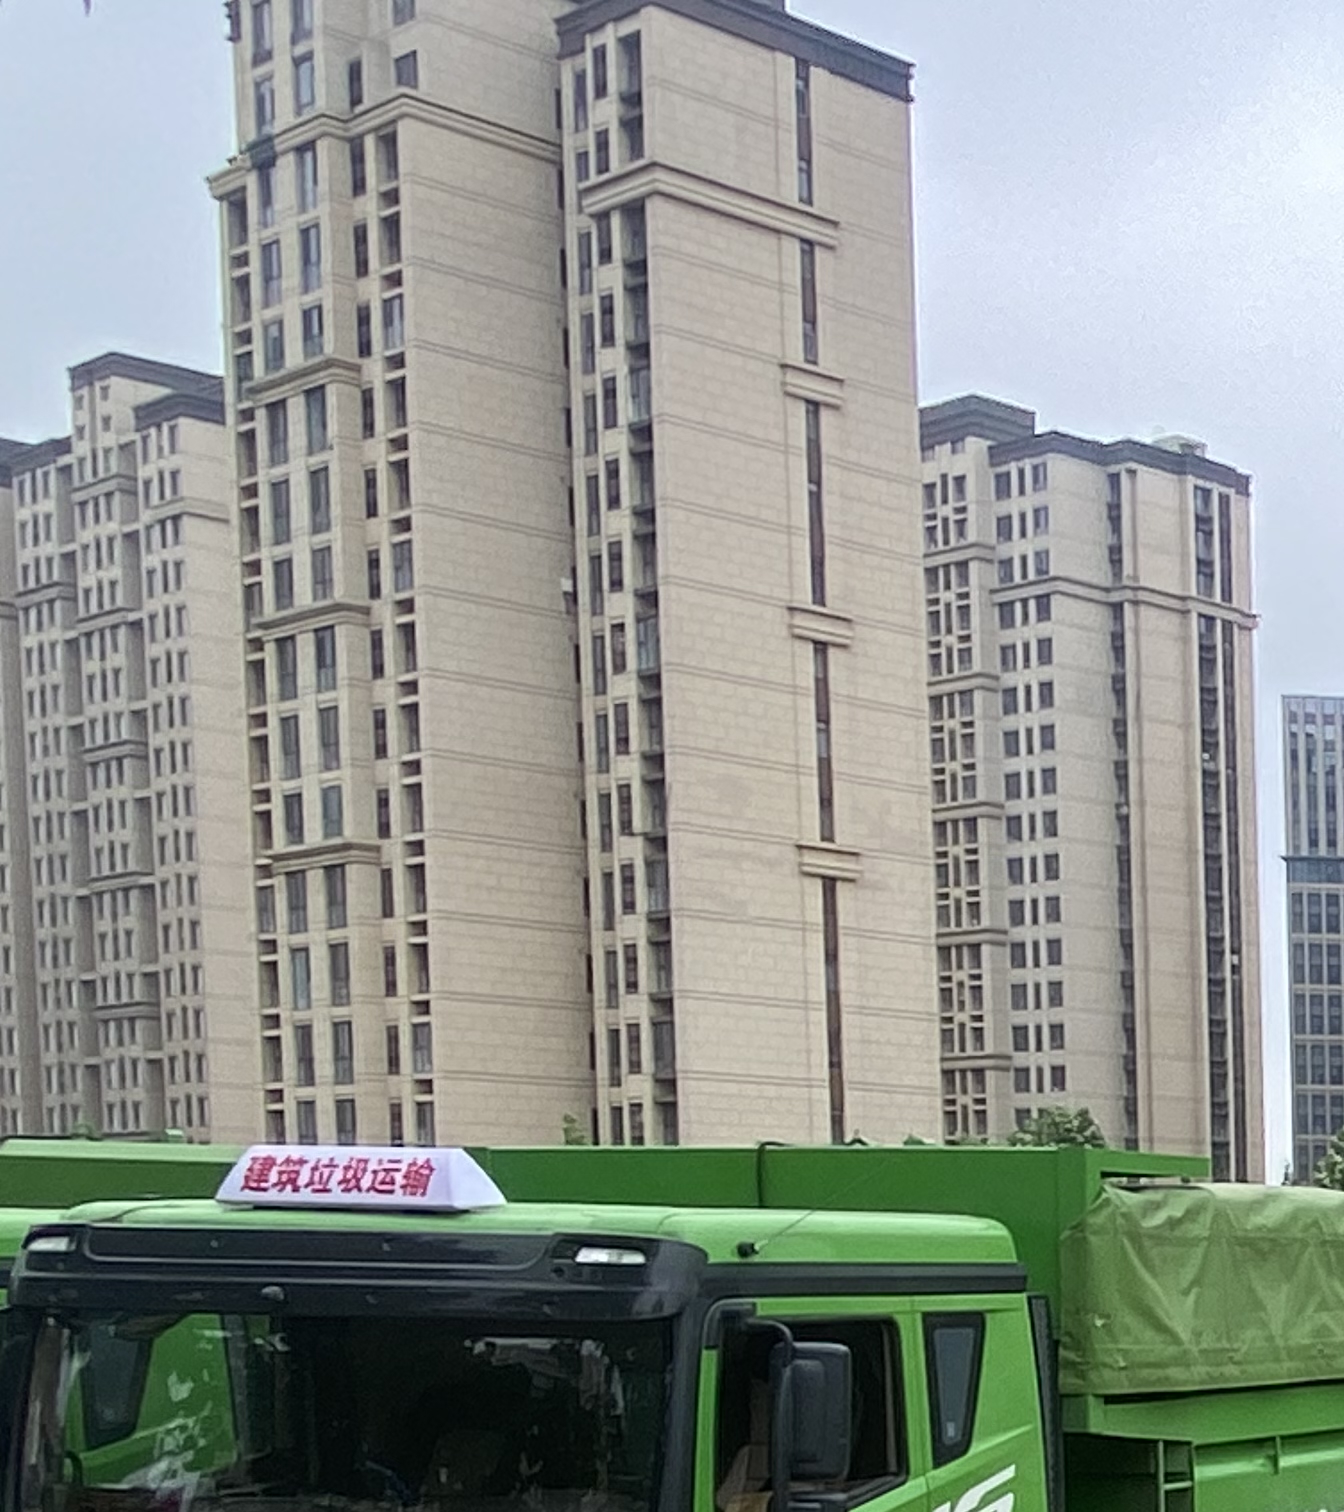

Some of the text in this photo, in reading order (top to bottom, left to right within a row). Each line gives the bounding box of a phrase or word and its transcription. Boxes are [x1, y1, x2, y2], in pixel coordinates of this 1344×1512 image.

[240, 1154, 436, 1198] 建筑垃圾运输
